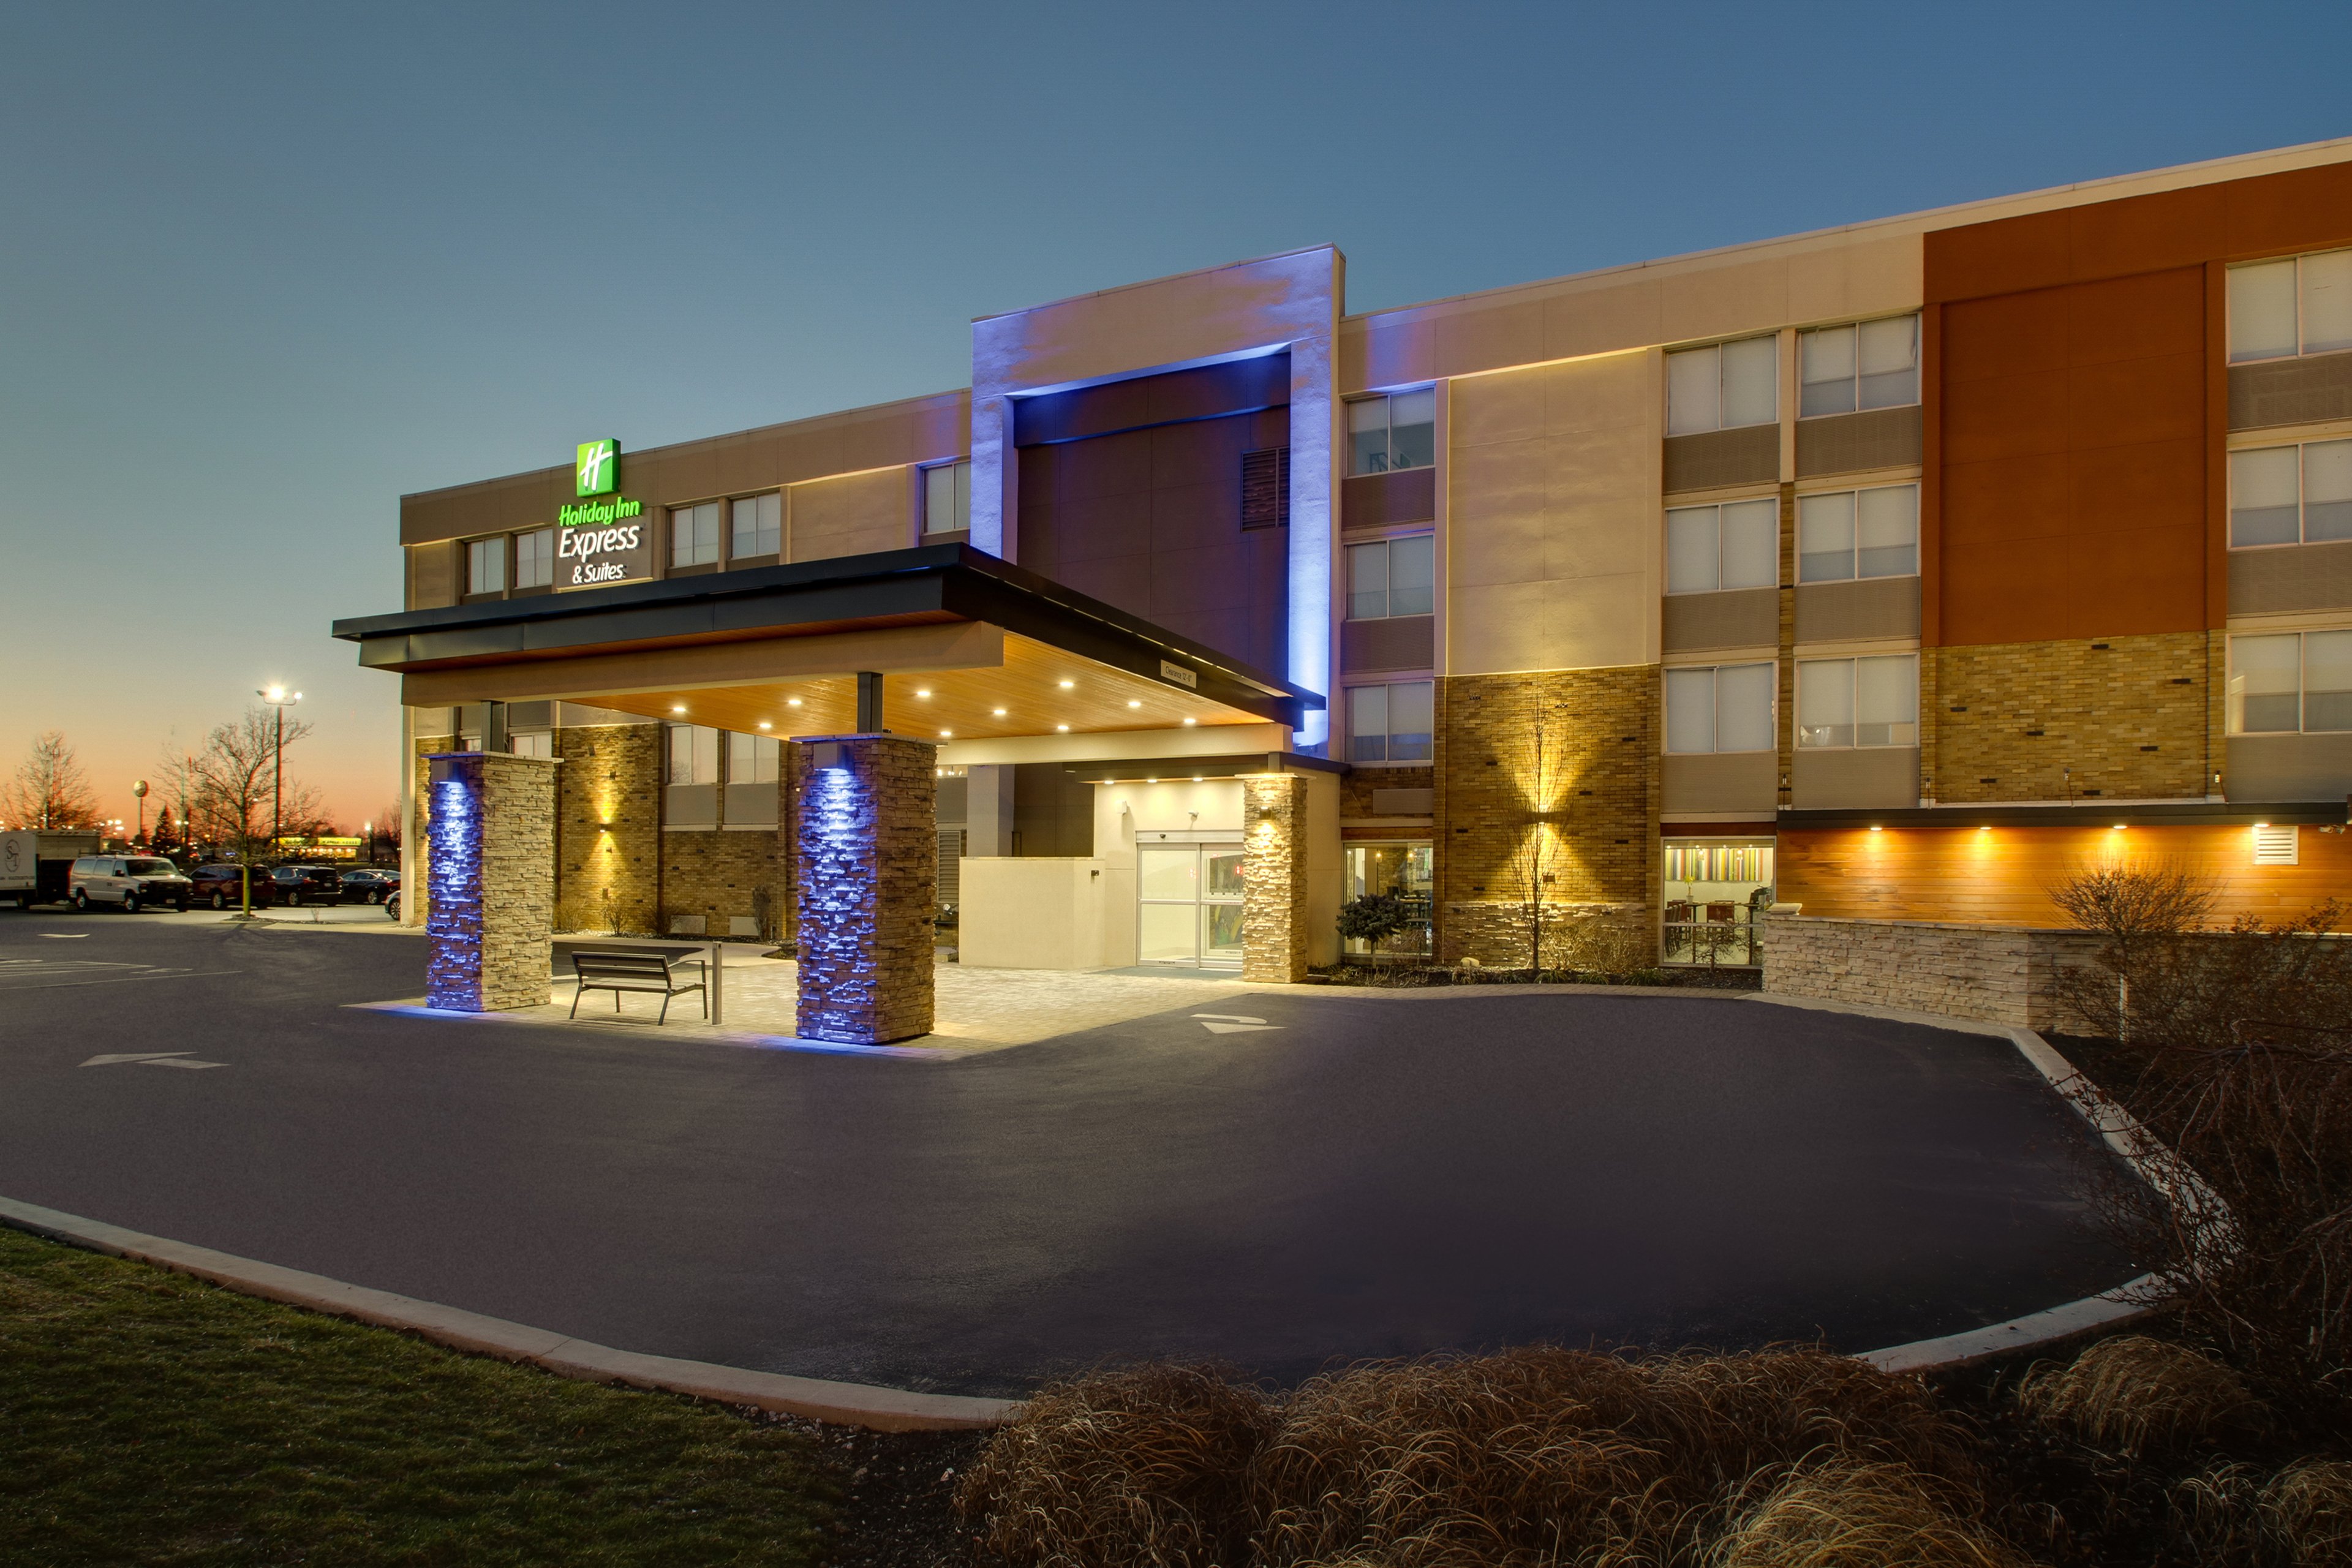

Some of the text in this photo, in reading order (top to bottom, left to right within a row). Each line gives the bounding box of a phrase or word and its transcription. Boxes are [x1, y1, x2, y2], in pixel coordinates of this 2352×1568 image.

[579, 442, 613, 491] H
[559, 496, 640, 527] Holiday Inn
[559, 525, 639, 563] Express
[572, 562, 624, 584] & Suites
[1166, 666, 1182, 679] Clearance
